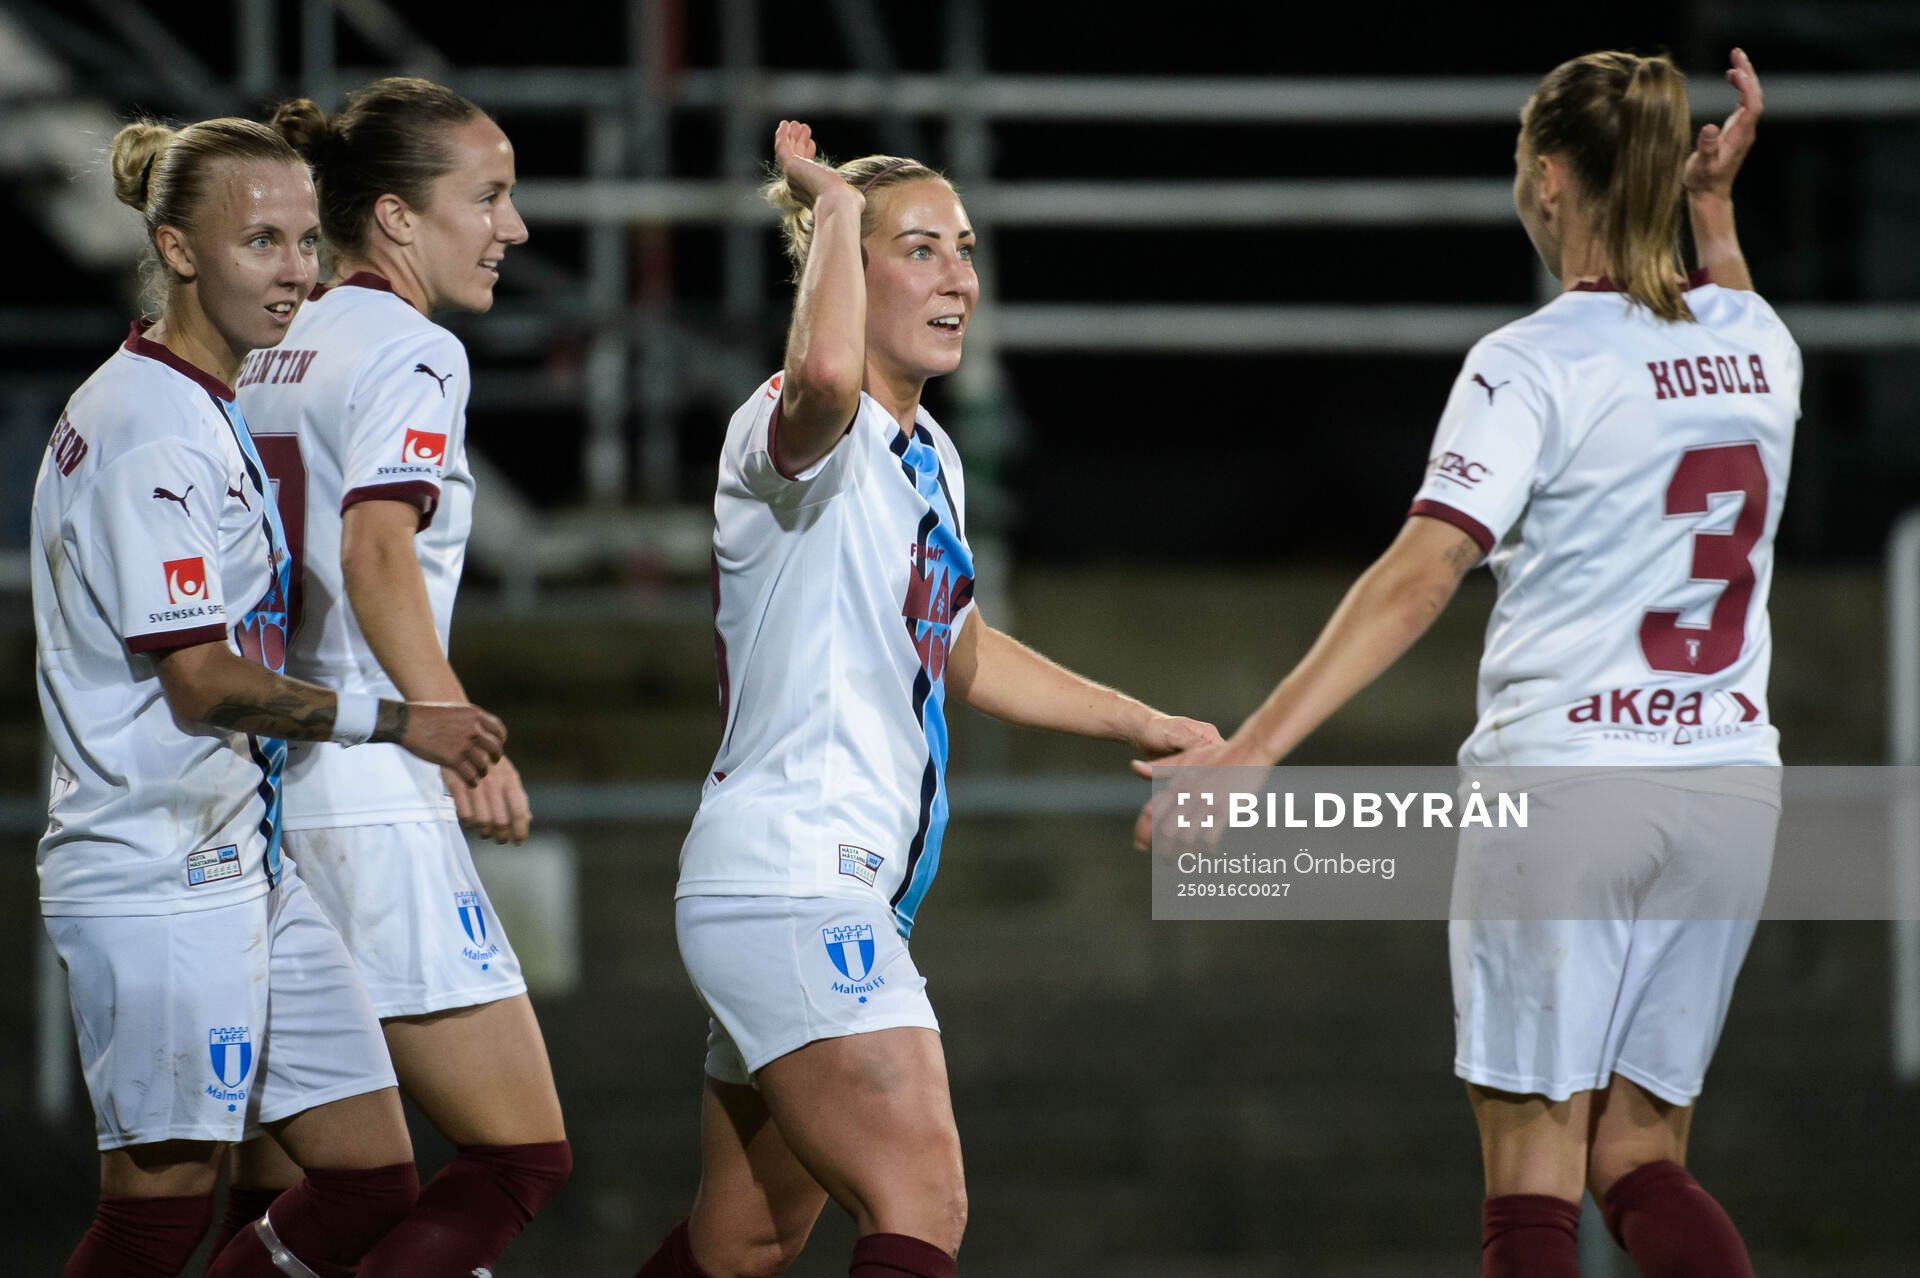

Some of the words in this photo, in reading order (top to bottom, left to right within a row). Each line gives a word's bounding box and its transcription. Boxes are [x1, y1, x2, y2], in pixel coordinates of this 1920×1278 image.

[238, 350, 318, 388] LENTIN
[1647, 354, 1771, 400] KOSOLA
[377, 466, 432, 475] SVENSKA
[1638, 439, 1769, 676] 3
[149, 607, 205, 623] SVENSKA
[1568, 689, 1703, 726] akea
[1697, 726, 1742, 740] ELEDA
[831, 981, 873, 994] Malmö
[873, 975, 886, 988] FF
[206, 1084, 246, 1101] Malmö
